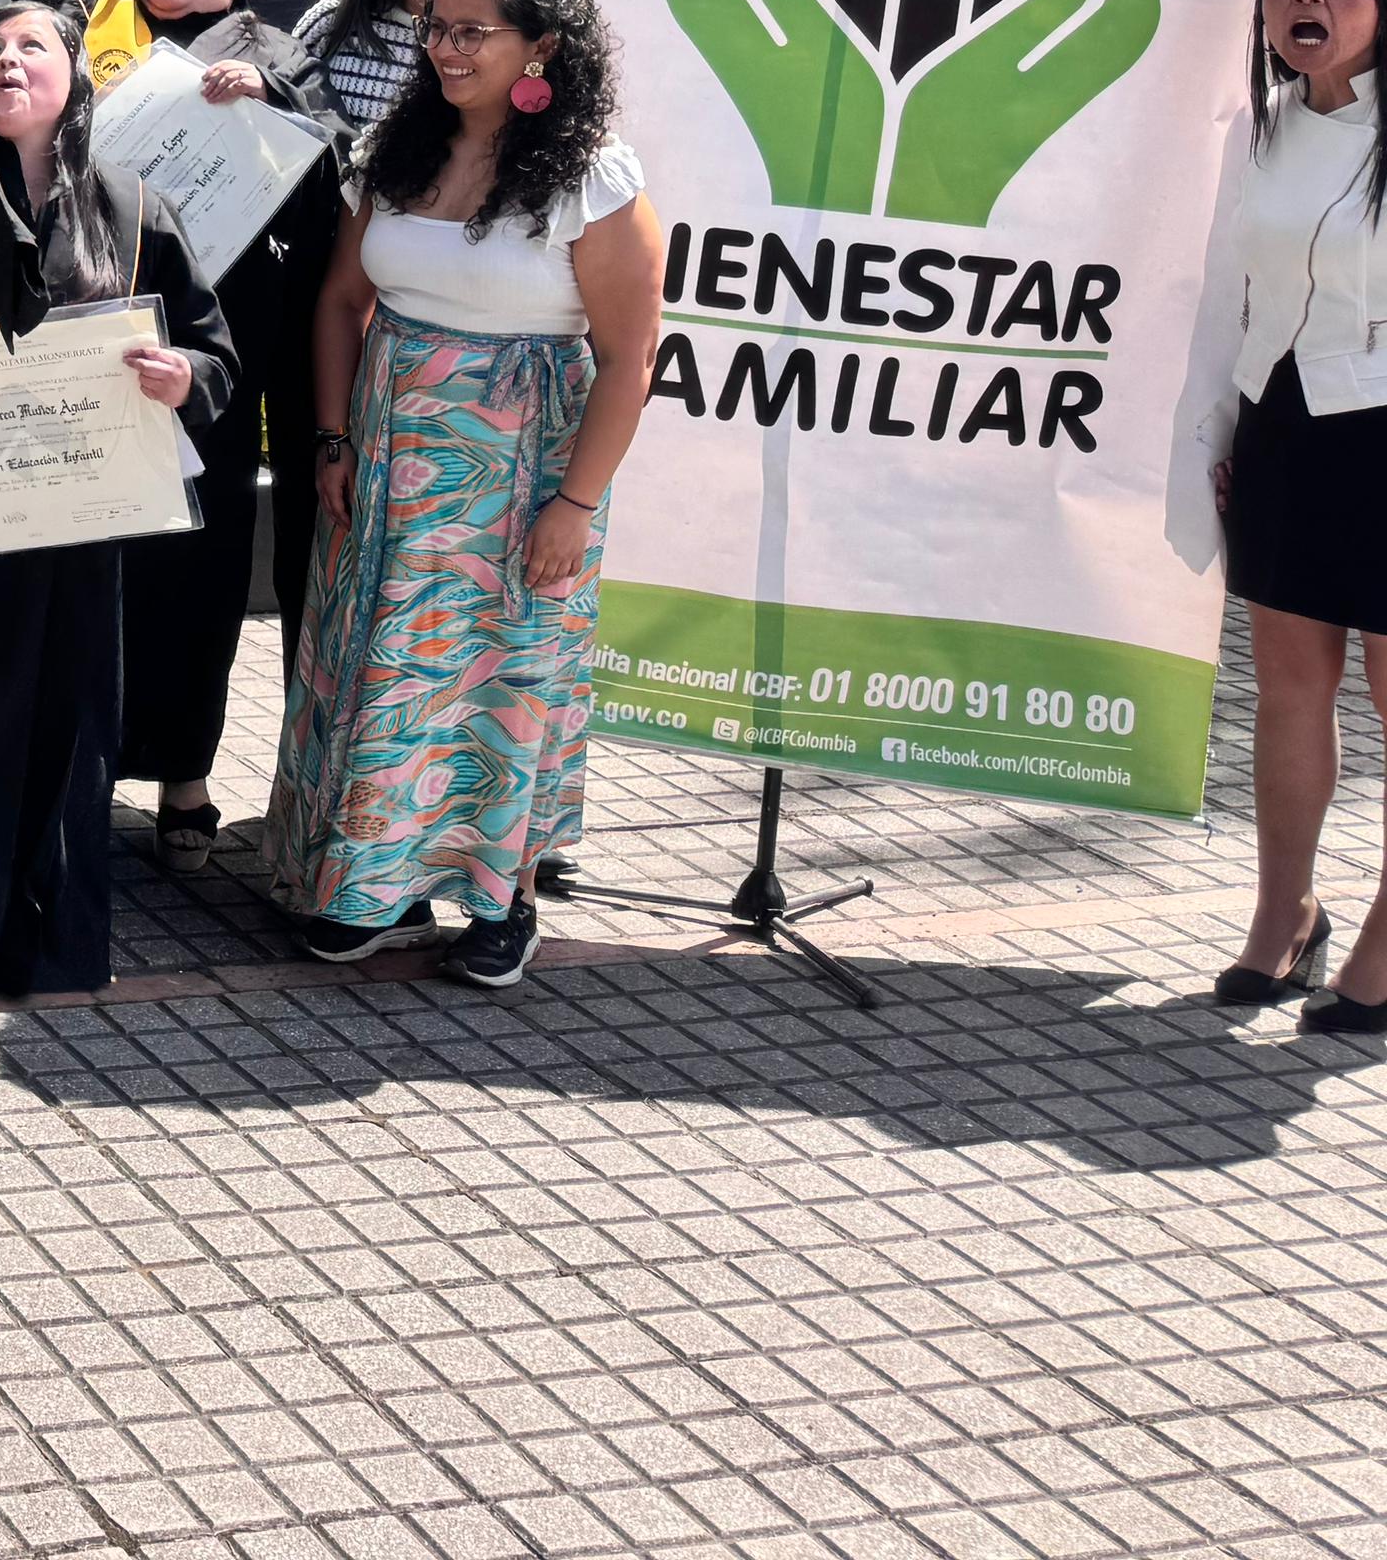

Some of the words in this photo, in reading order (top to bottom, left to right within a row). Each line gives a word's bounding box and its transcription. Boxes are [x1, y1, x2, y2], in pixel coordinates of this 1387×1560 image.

[193, 152, 228, 191] Infantil
[662, 222, 1121, 344] IENESTAR
[15, 399, 57, 419] Muñoz
[56, 394, 102, 417] Aguilar
[642, 332, 1104, 453] AMILIAR
[4, 452, 60, 472] Educación
[61, 446, 105, 465] Infantil
[637, 656, 736, 693] nacional
[743, 670, 802, 703] ICBF:
[809, 667, 850, 705] 01
[864, 672, 955, 715] 8000
[965, 682, 1008, 722] 91
[1025, 690, 1074, 731] 80
[1085, 695, 1135, 736] 80
[743, 725, 857, 755] @ICBFColombia
[909, 741, 1132, 787] facebook.com/ICBFColombia
